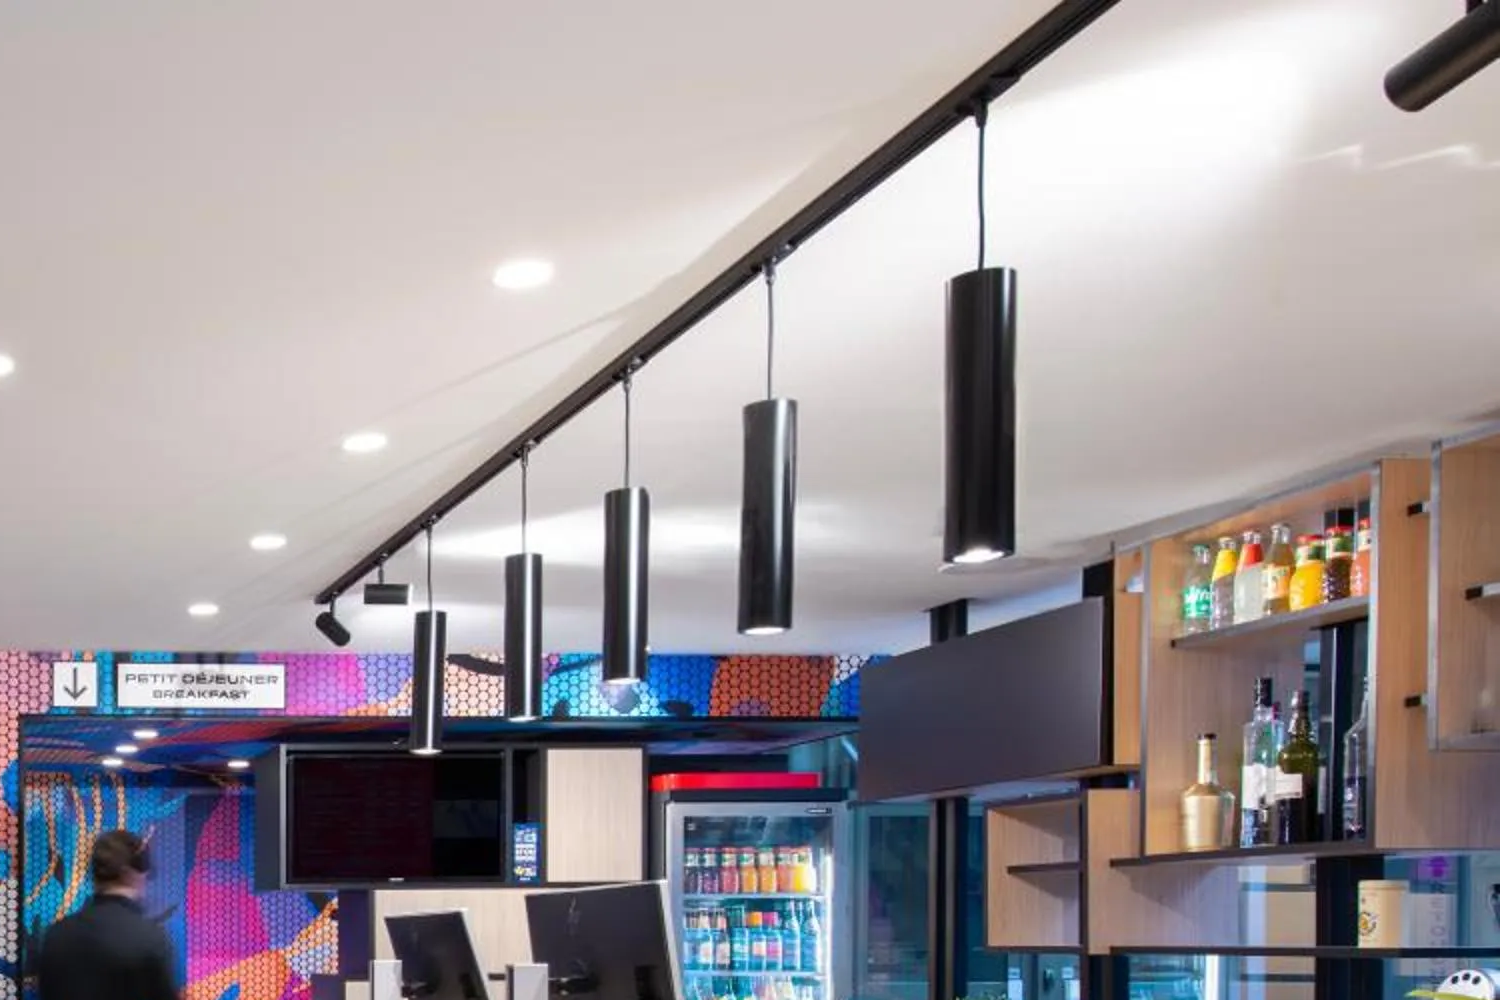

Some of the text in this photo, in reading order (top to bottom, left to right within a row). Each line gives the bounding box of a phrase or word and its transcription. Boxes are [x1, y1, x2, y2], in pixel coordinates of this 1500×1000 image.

[125, 671, 279, 685] PETIT DÉJEUNER
[152, 689, 250, 700] BREAKFAST
